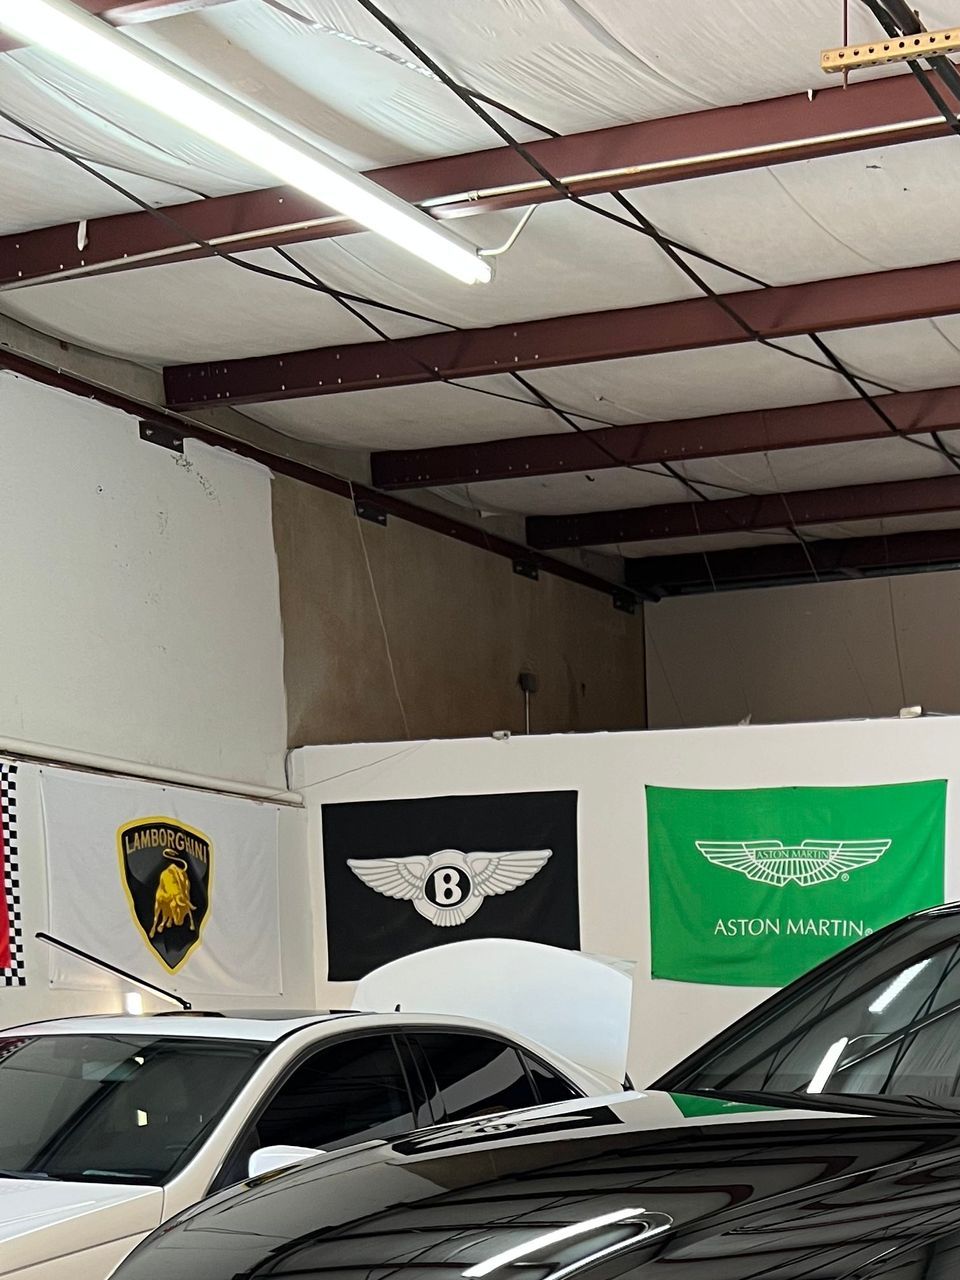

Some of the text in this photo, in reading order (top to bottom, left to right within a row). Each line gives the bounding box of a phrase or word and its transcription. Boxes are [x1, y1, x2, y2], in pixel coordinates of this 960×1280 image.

[125, 828, 208, 864] LAMBORGHINI
[756, 850, 830, 860] ASTON MARTIN
[433, 868, 463, 905] B
[714, 918, 864, 937] ASTON MARTIN
